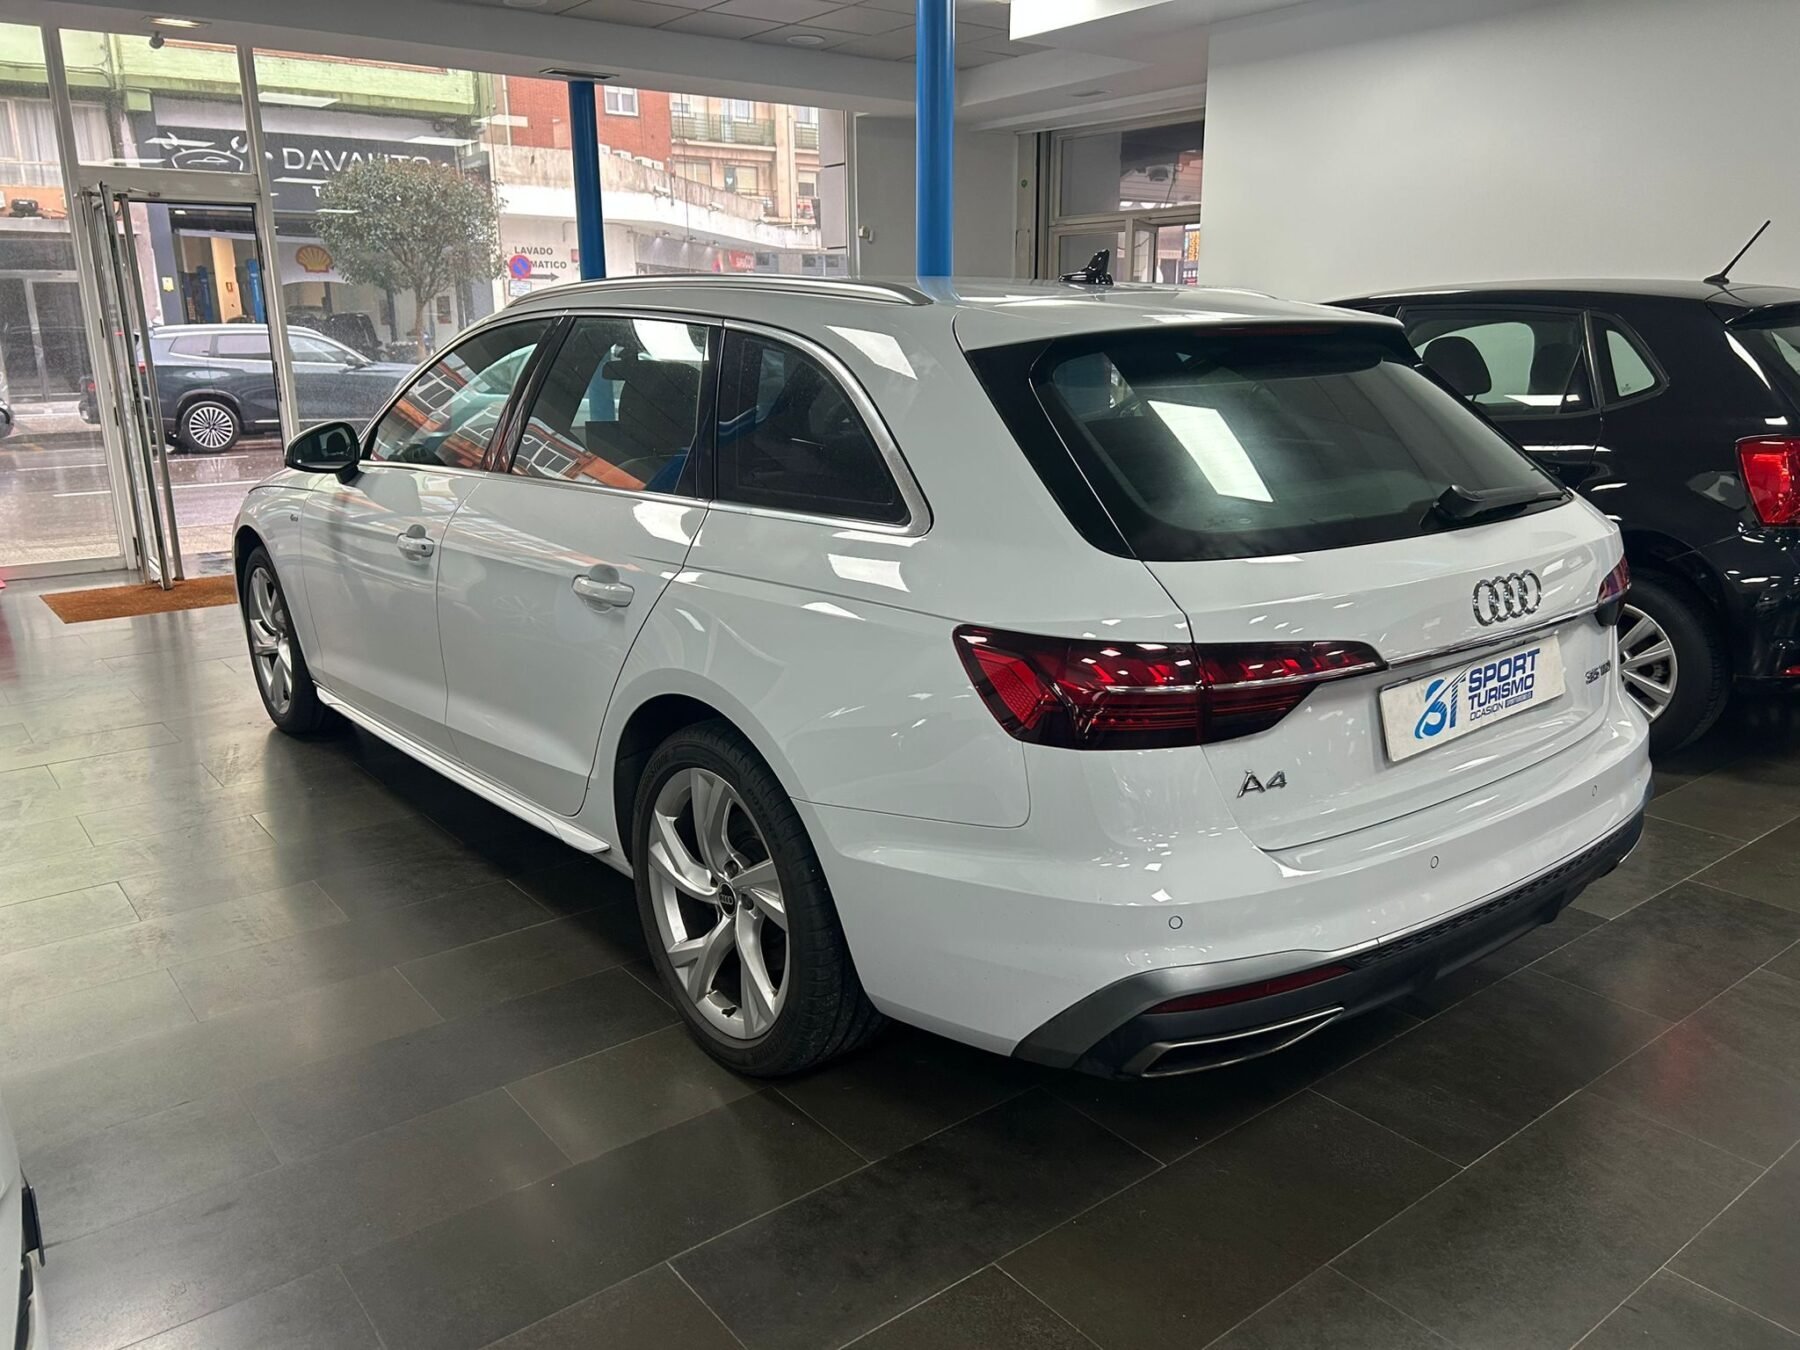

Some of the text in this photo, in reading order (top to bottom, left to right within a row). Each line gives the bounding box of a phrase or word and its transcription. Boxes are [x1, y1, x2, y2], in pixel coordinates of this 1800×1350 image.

[514, 246, 553, 255] LAVADO
[1468, 648, 1540, 693] SPORT
[1468, 673, 1535, 710] TURISMO
[1469, 701, 1504, 721] OCASION
[1236, 769, 1287, 799] A4
